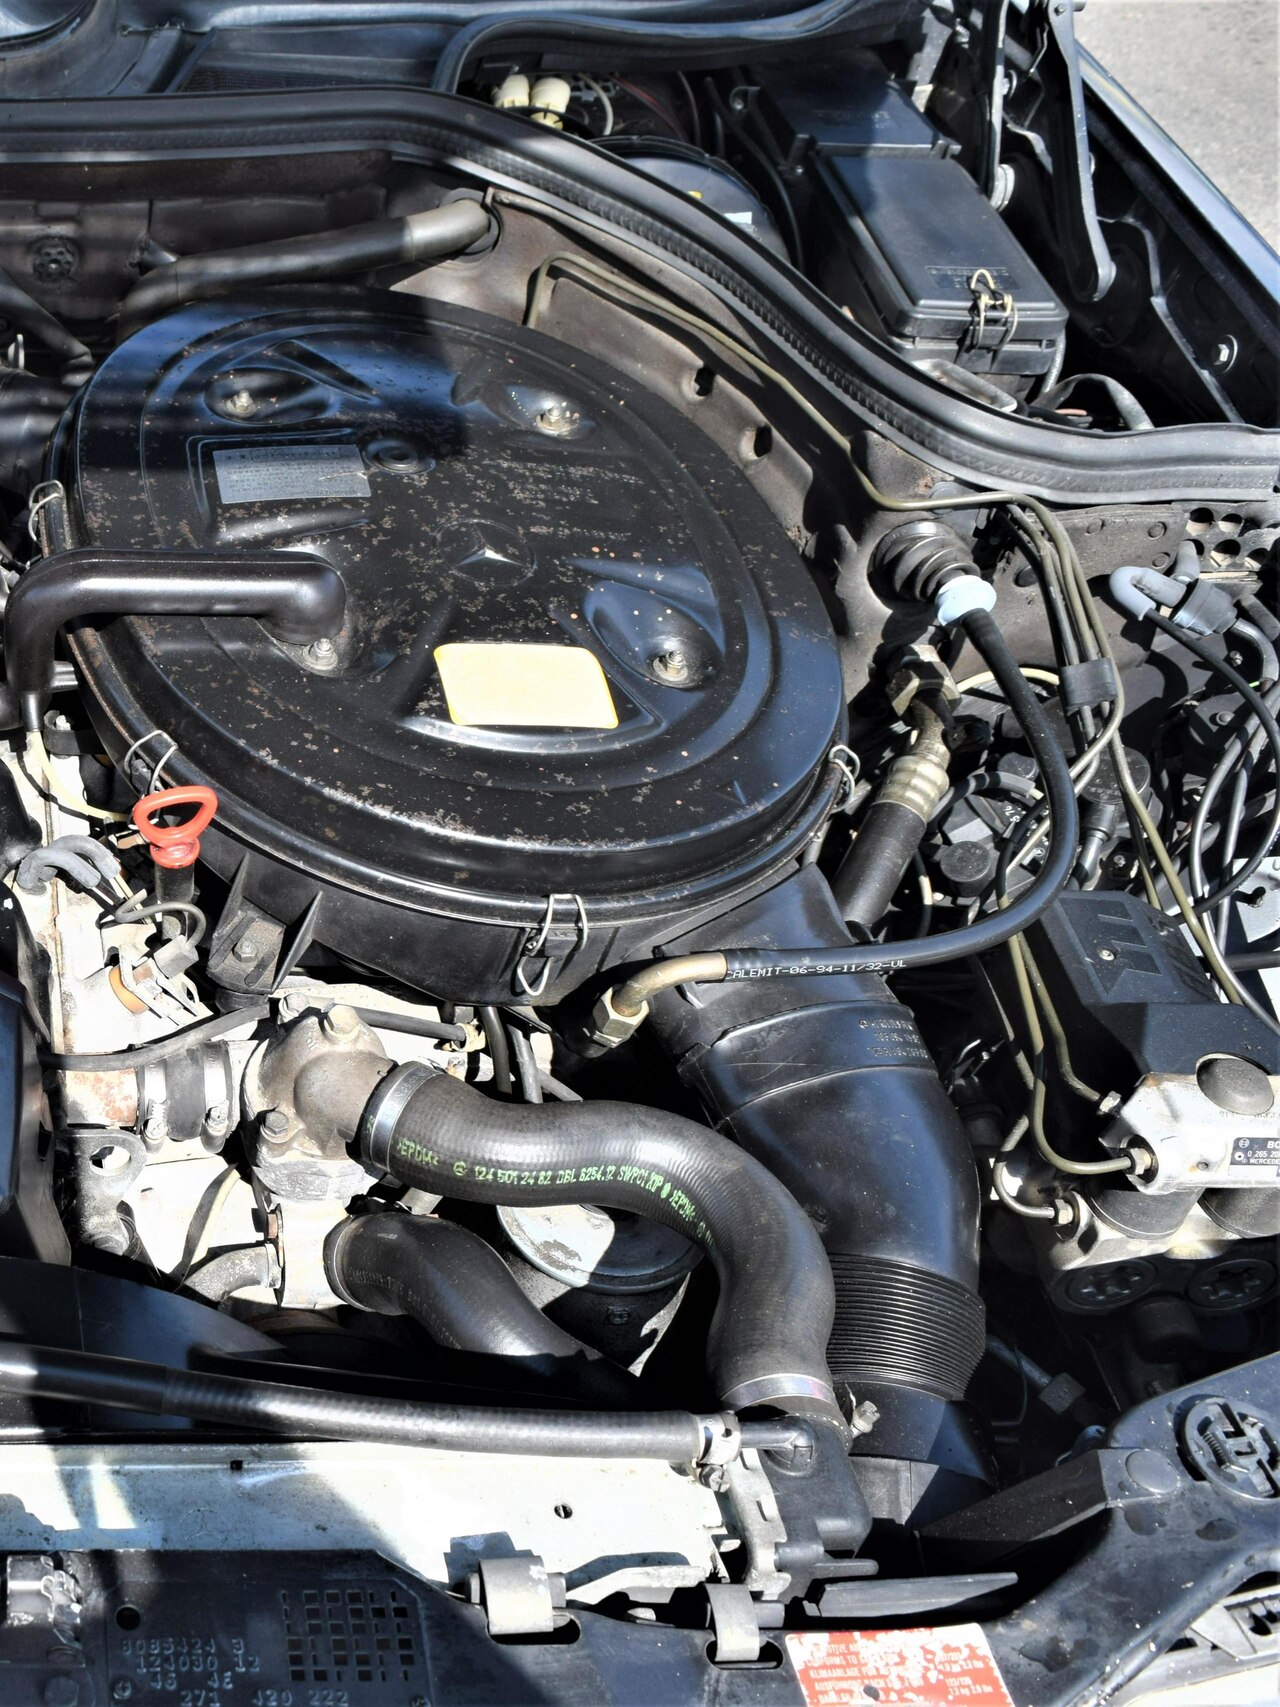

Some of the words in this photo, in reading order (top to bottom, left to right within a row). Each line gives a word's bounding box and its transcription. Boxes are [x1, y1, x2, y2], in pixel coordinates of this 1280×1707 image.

[475, 1166, 495, 1182] 124
[497, 1169, 519, 1184] 501
[520, 1171, 537, 1185] 24
[538, 1170, 552, 1185] 82
[556, 1168, 577, 1184] DBL
[579, 1165, 617, 1182] 6254.12
[234, 1655, 260, 1673] 12
[308, 1690, 349, 1707] 222
